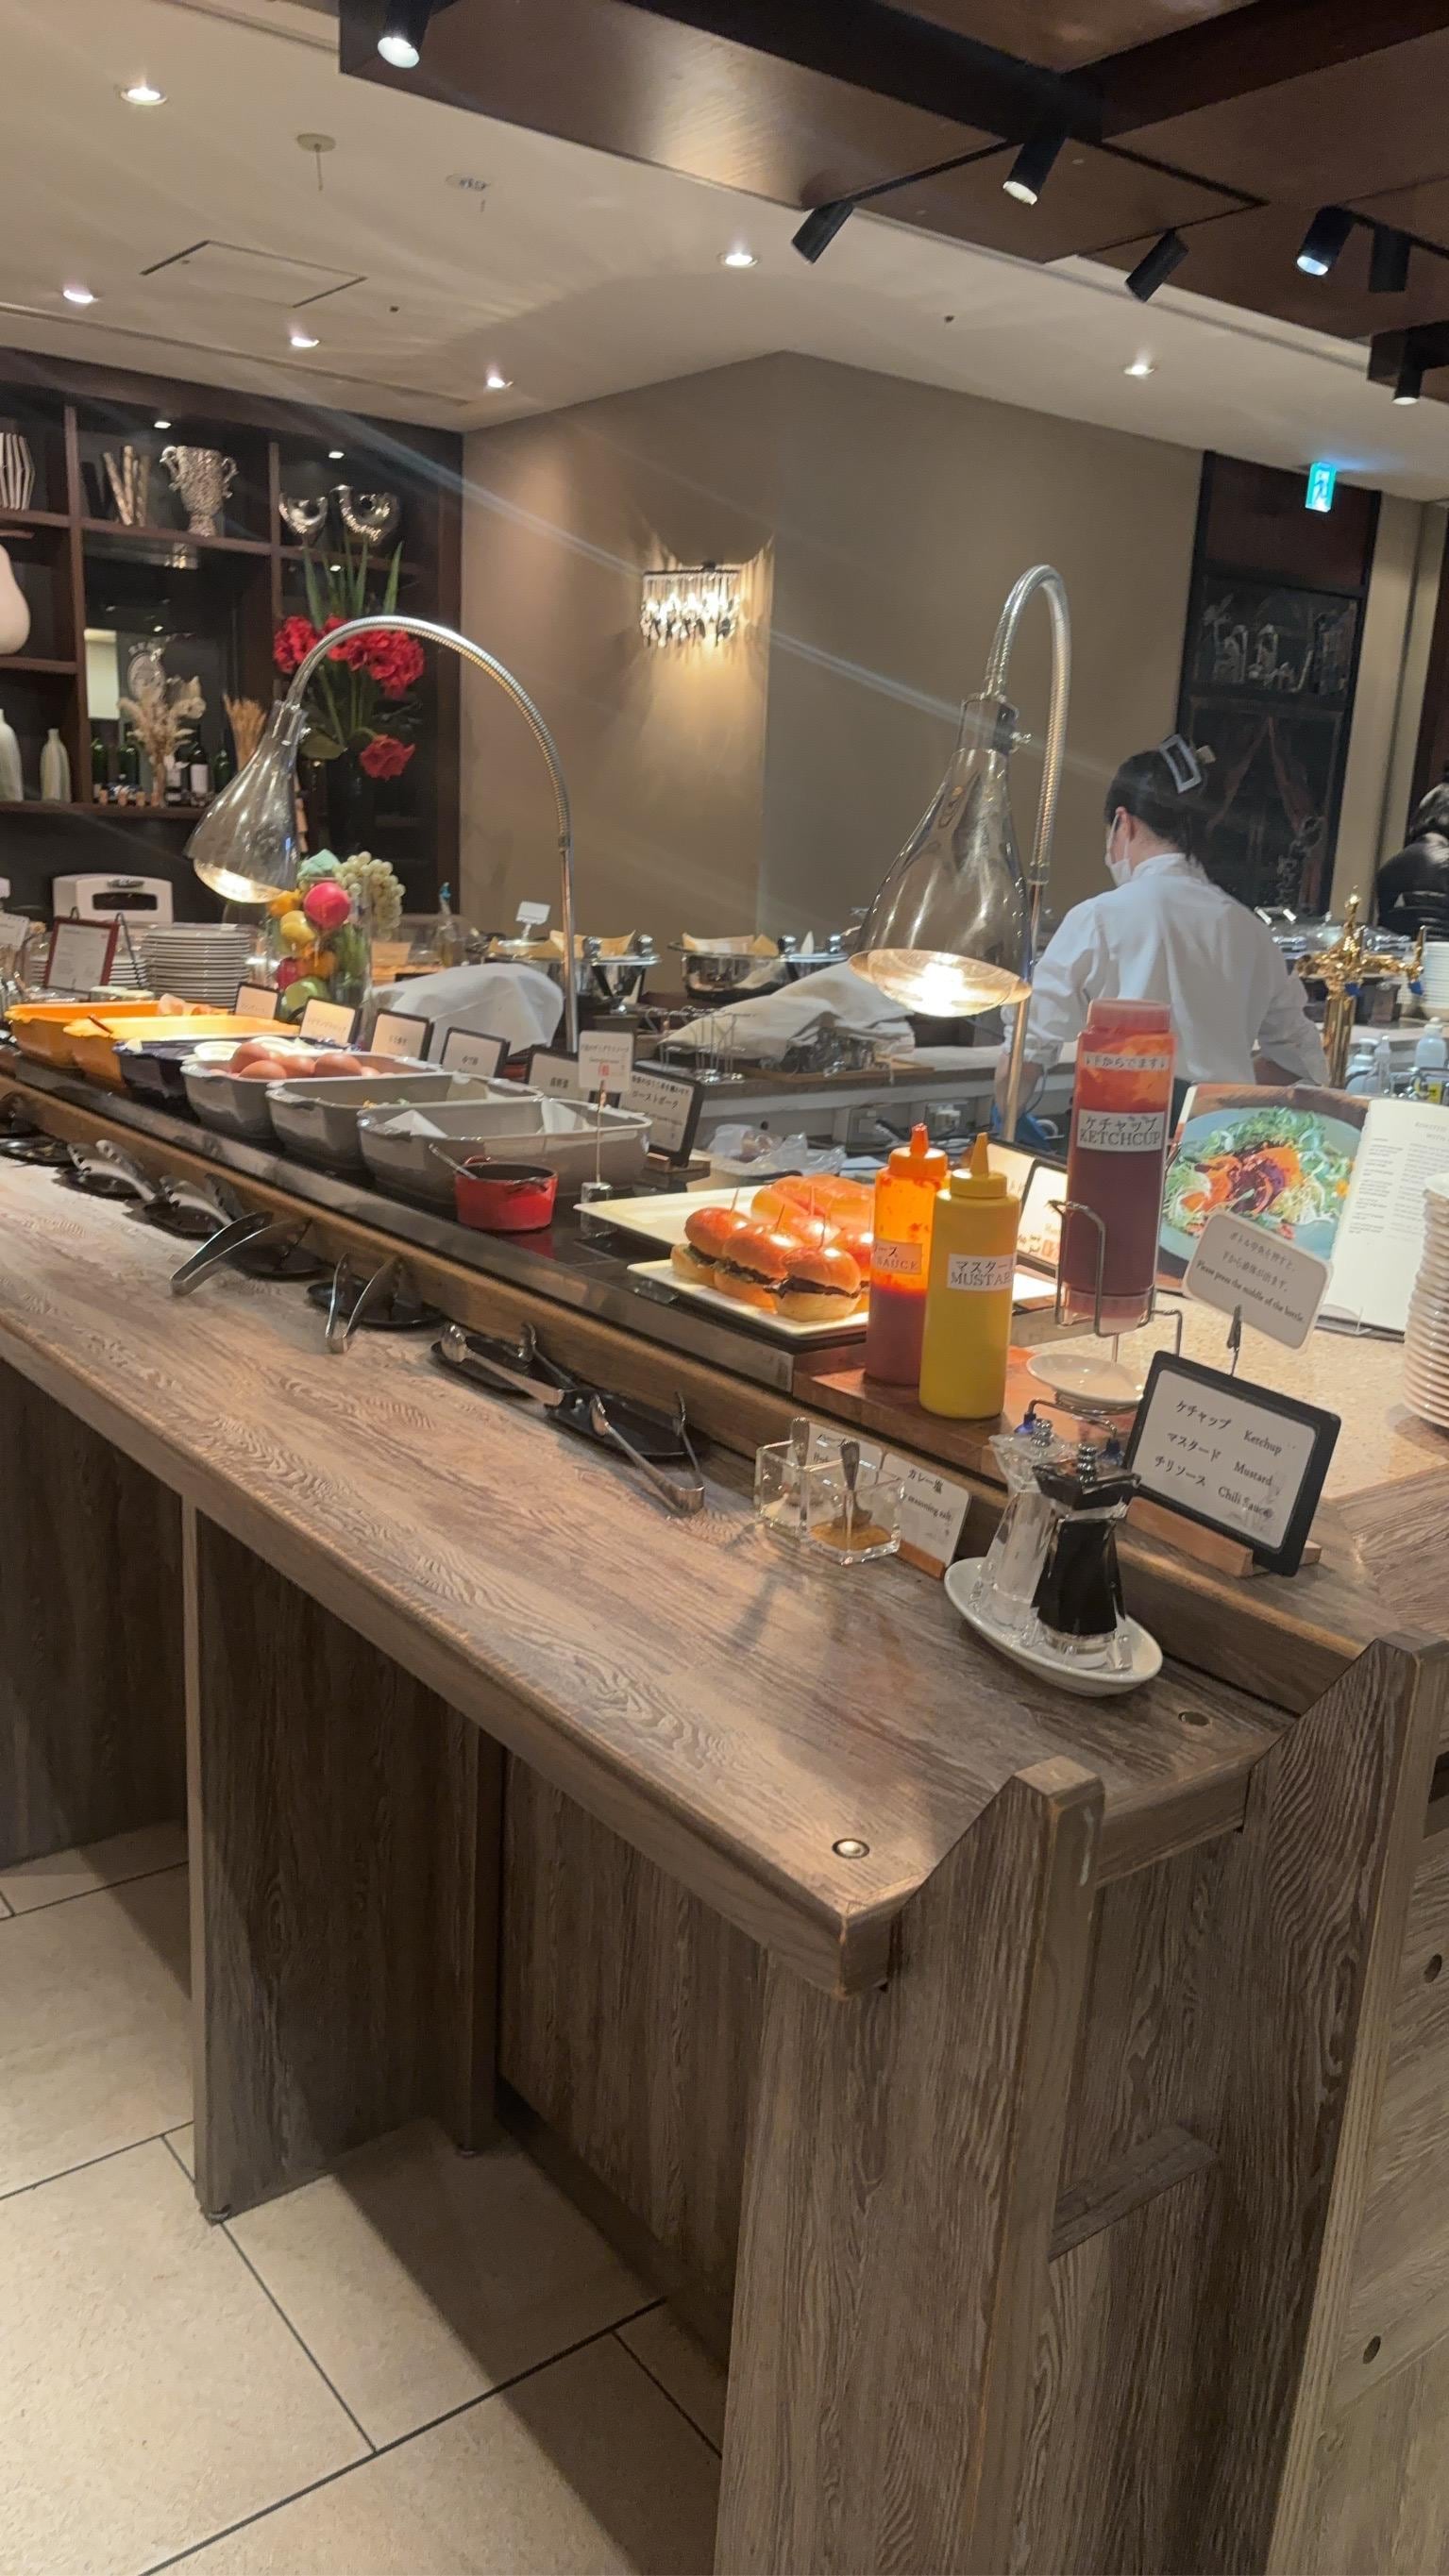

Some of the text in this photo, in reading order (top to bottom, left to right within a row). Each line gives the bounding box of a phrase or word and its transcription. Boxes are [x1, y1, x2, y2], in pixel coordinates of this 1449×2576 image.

[1086, 1115, 1157, 1133] ケチャップ
[1176, 1400, 1232, 1431] ケチャップ
[1167, 1432, 1222, 1463] マスタード
[1242, 1429, 1283, 1456] Ketchup
[1154, 1455, 1206, 1487] チリソース
[1234, 1460, 1273, 1487] Mustard
[1218, 1485, 1241, 1504] Chili
